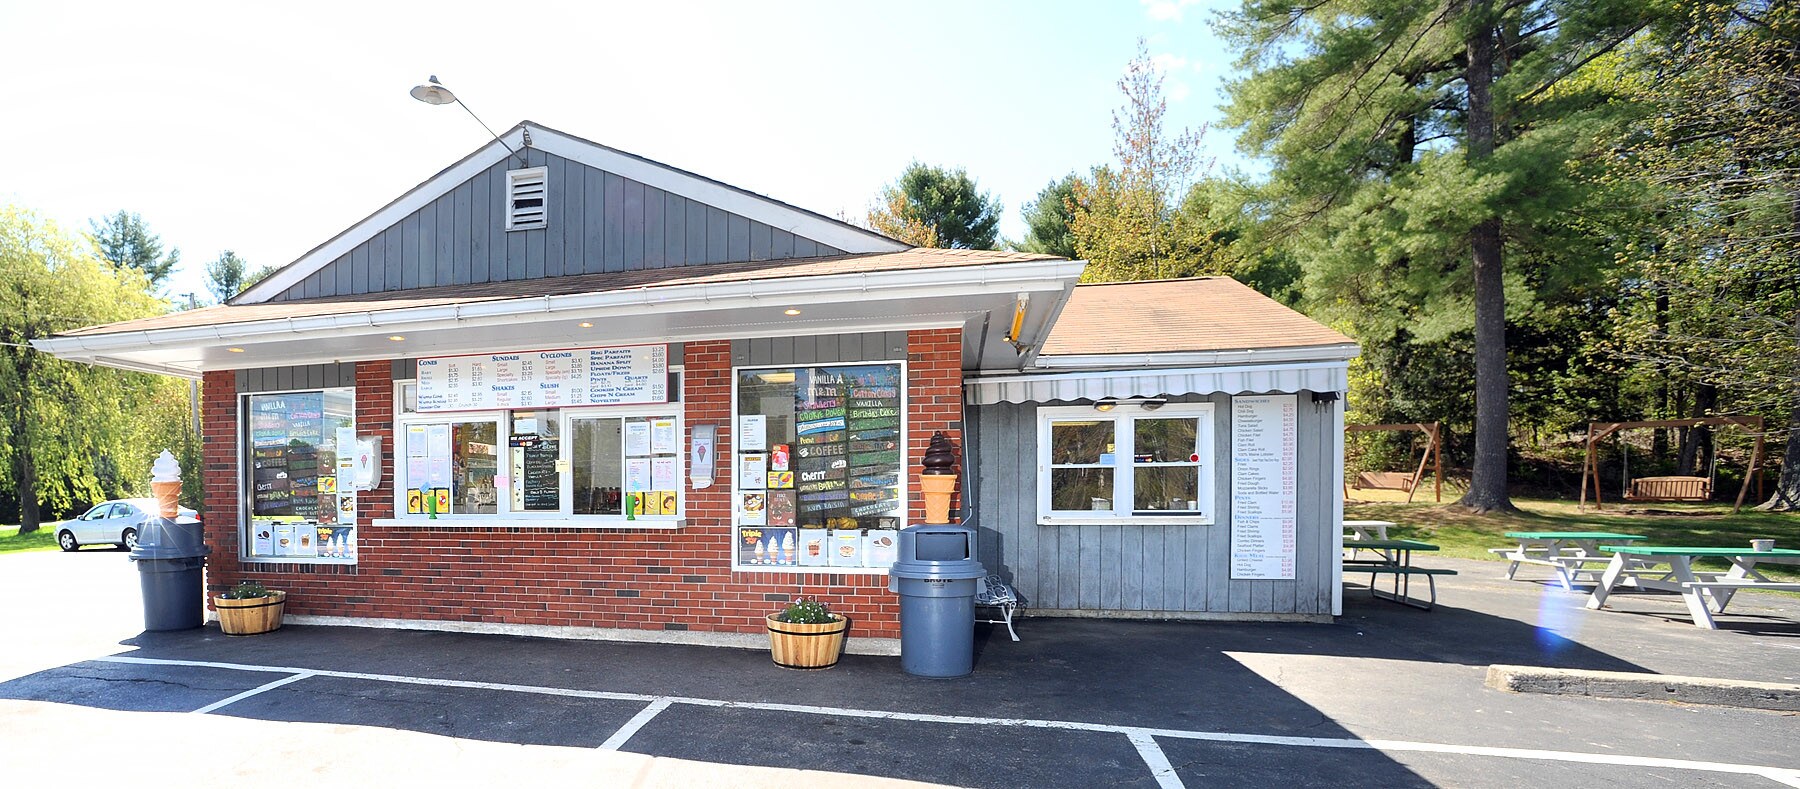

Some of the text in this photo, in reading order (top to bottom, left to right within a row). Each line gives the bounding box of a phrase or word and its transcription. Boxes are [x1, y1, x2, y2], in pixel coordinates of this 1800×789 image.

[810, 445, 843, 455] COFFEE
[802, 471, 826, 481] Cherry
[742, 530, 762, 538] Triple
